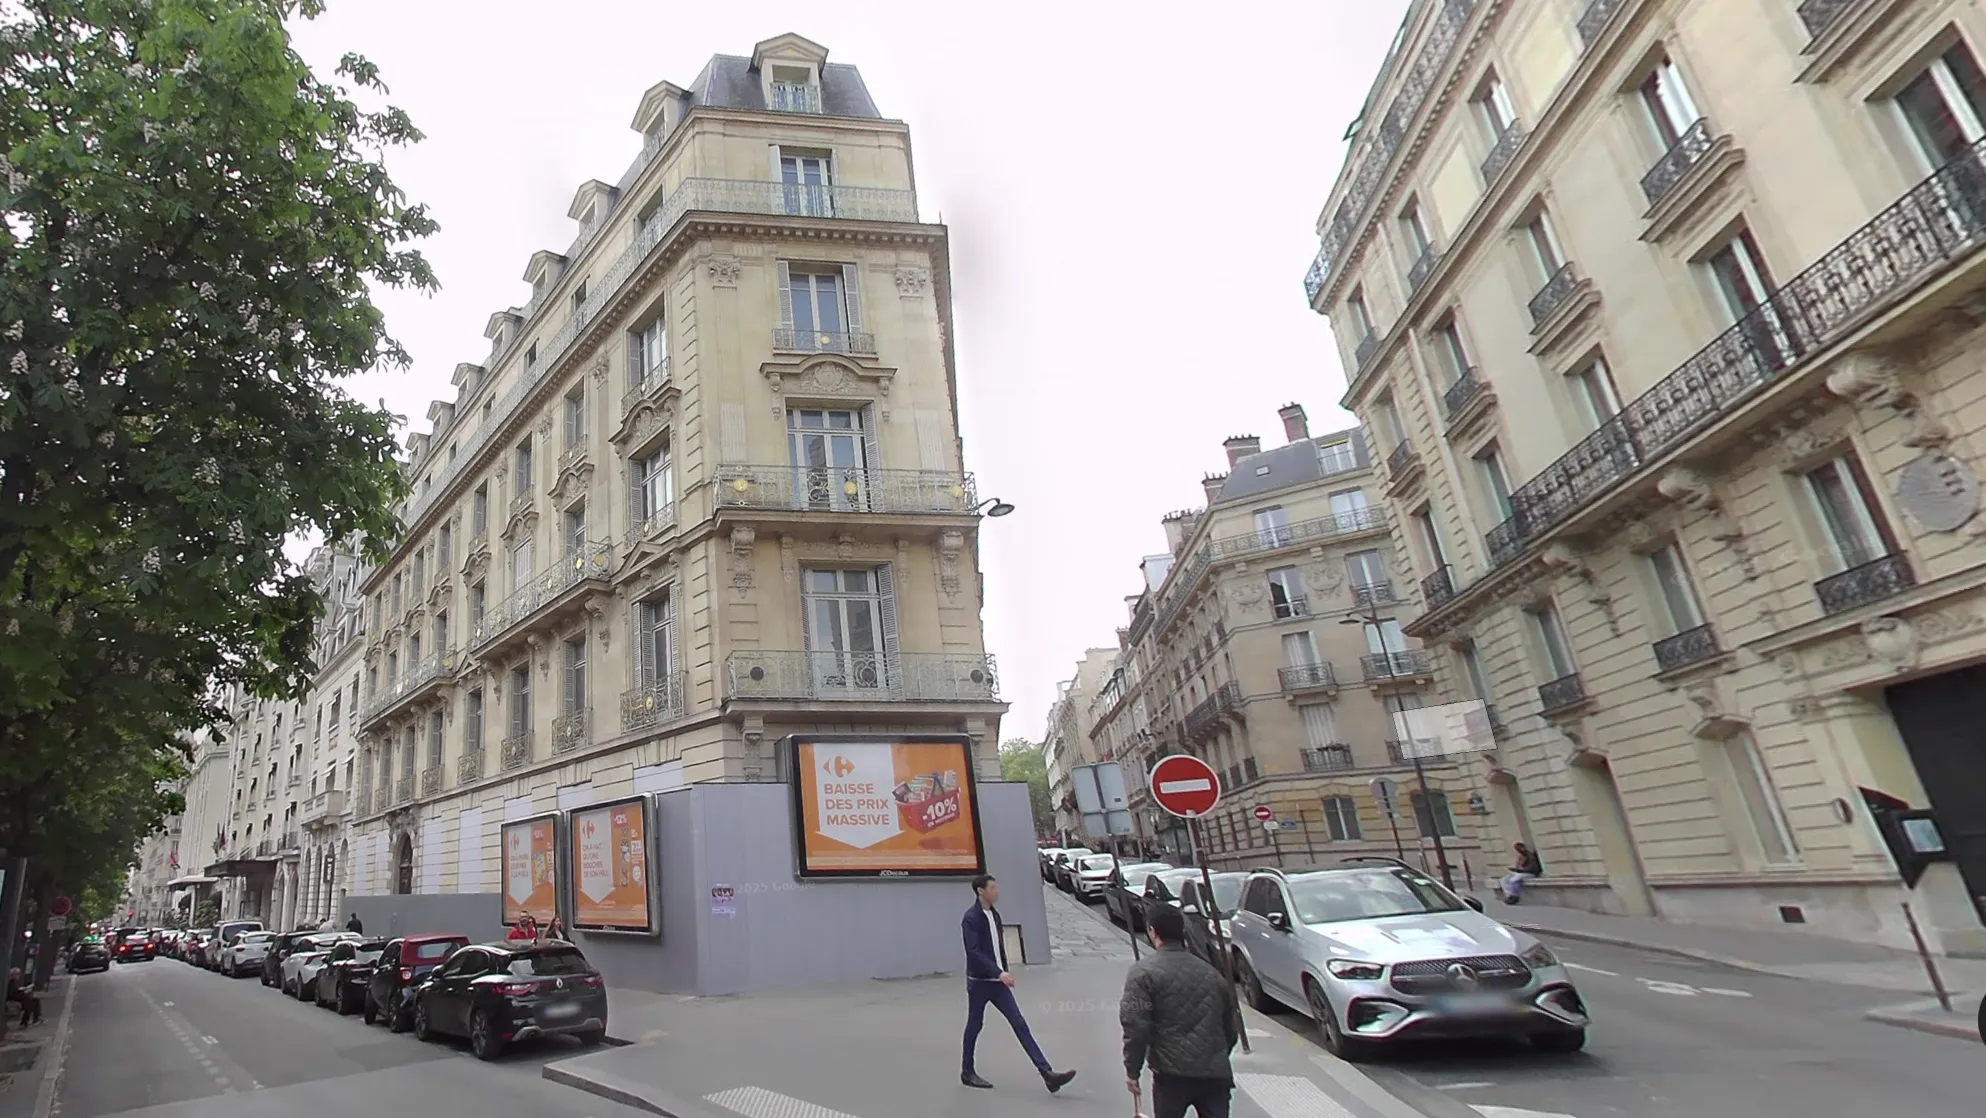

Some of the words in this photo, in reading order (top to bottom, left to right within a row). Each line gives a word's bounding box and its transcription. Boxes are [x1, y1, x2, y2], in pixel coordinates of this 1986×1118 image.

[824, 783, 874, 795] BAISSE
[825, 799, 853, 810] DES
[856, 798, 889, 810] PRIX
[922, 796, 957, 820] -10%
[826, 814, 890, 825] MASSIVE
